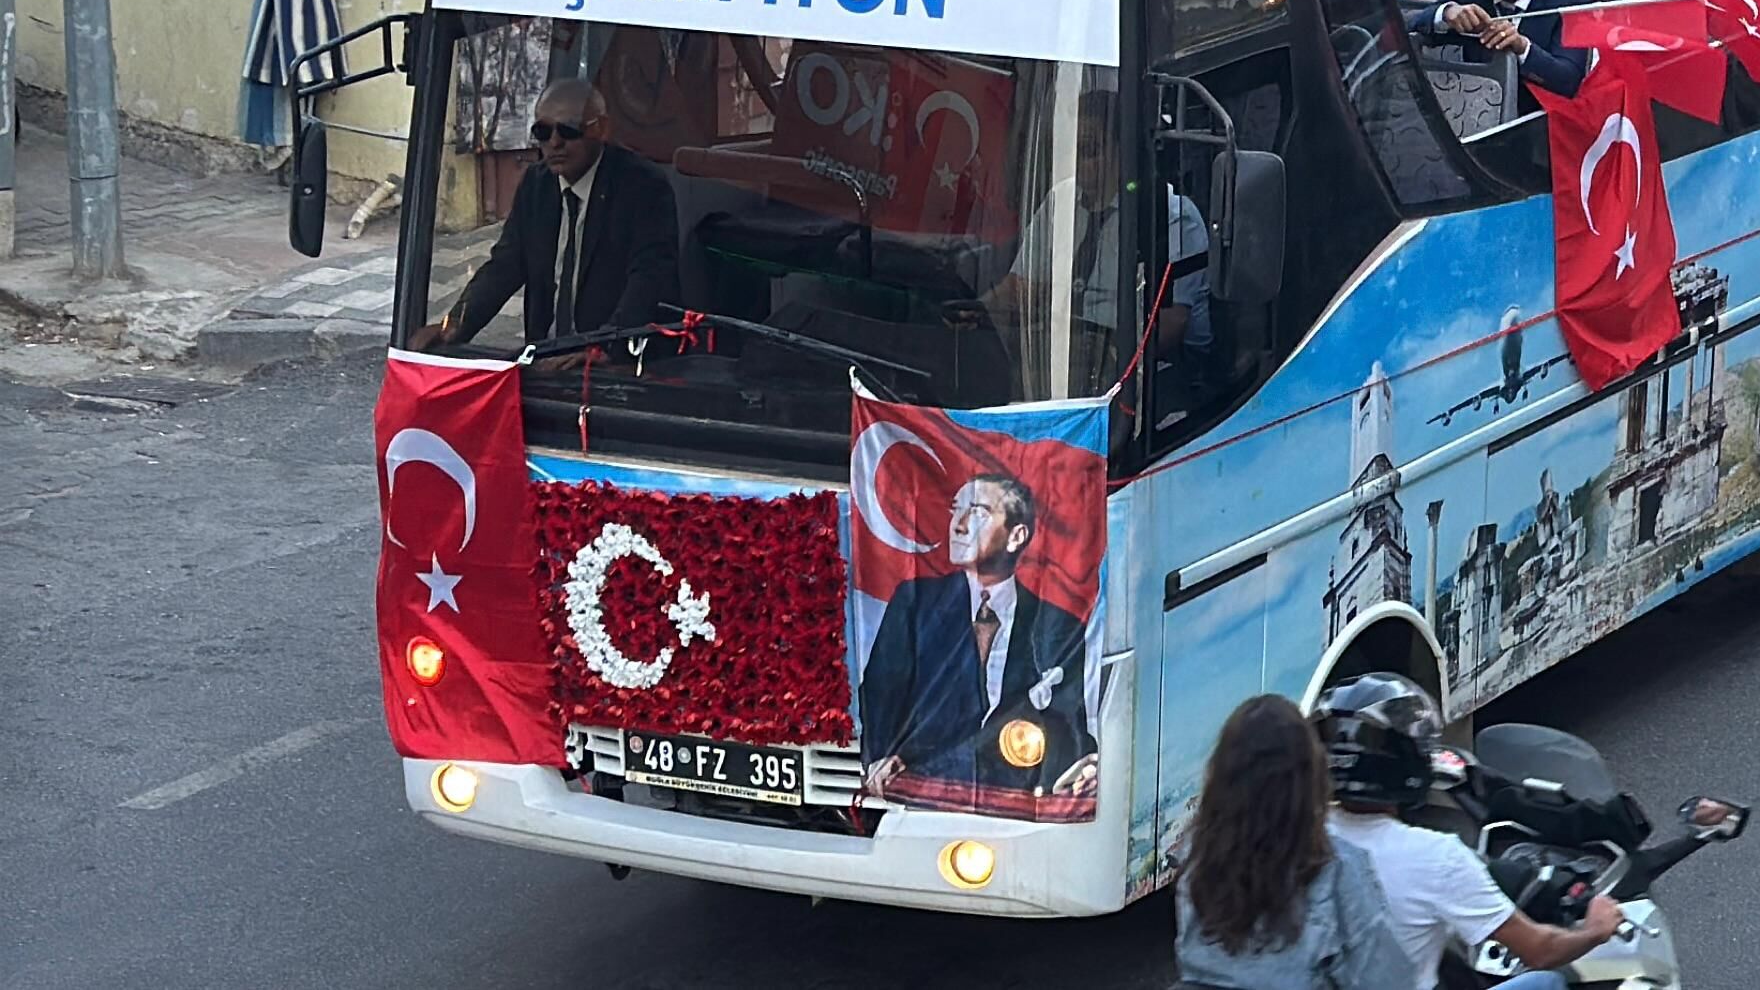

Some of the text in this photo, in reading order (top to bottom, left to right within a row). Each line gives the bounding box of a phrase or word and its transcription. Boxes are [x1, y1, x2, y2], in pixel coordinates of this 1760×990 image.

[644, 739, 797, 790] 48 FZ 395
